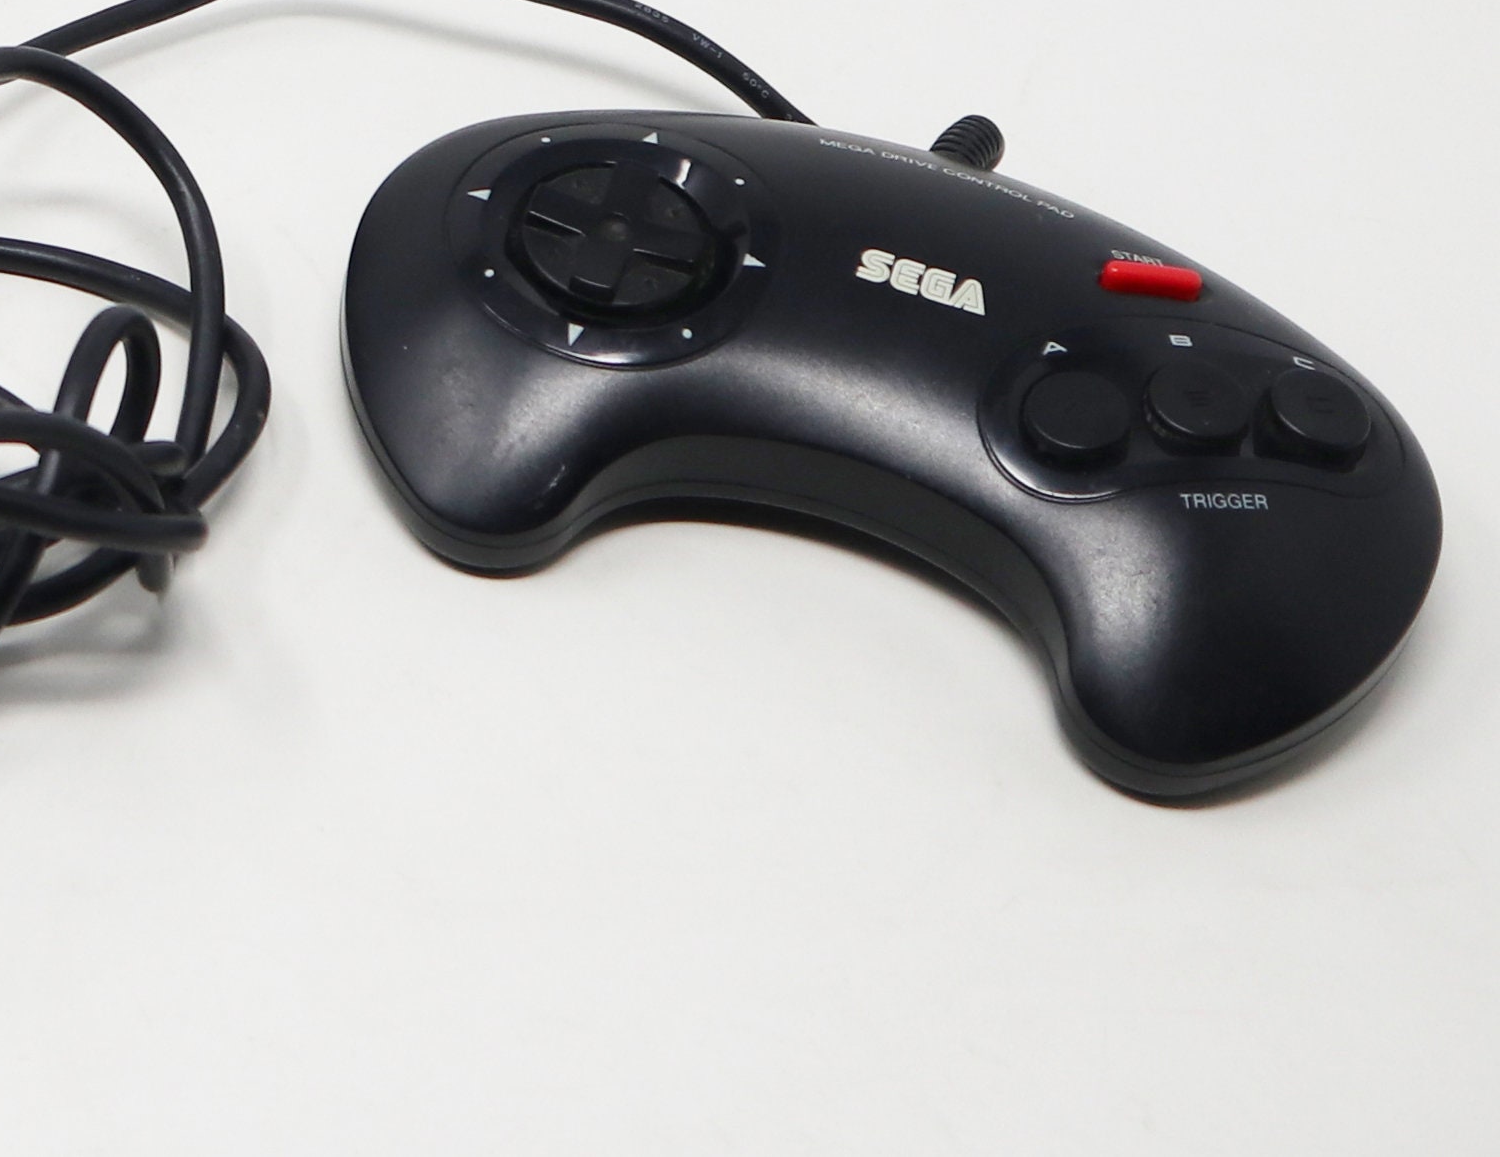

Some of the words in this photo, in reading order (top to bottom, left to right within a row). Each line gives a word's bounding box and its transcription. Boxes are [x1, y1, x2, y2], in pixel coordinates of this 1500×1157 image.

[819, 137, 876, 155] MEGA
[881, 150, 938, 171] DRIVE
[943, 167, 1033, 203] CONTROL
[1036, 200, 1075, 219] PAD
[1111, 249, 1165, 267] START
[855, 248, 986, 316] SEGA
[1042, 341, 1068, 356] A
[1168, 334, 1194, 348] B
[1292, 356, 1316, 371] C
[1179, 492, 1269, 511] TRIGGER
